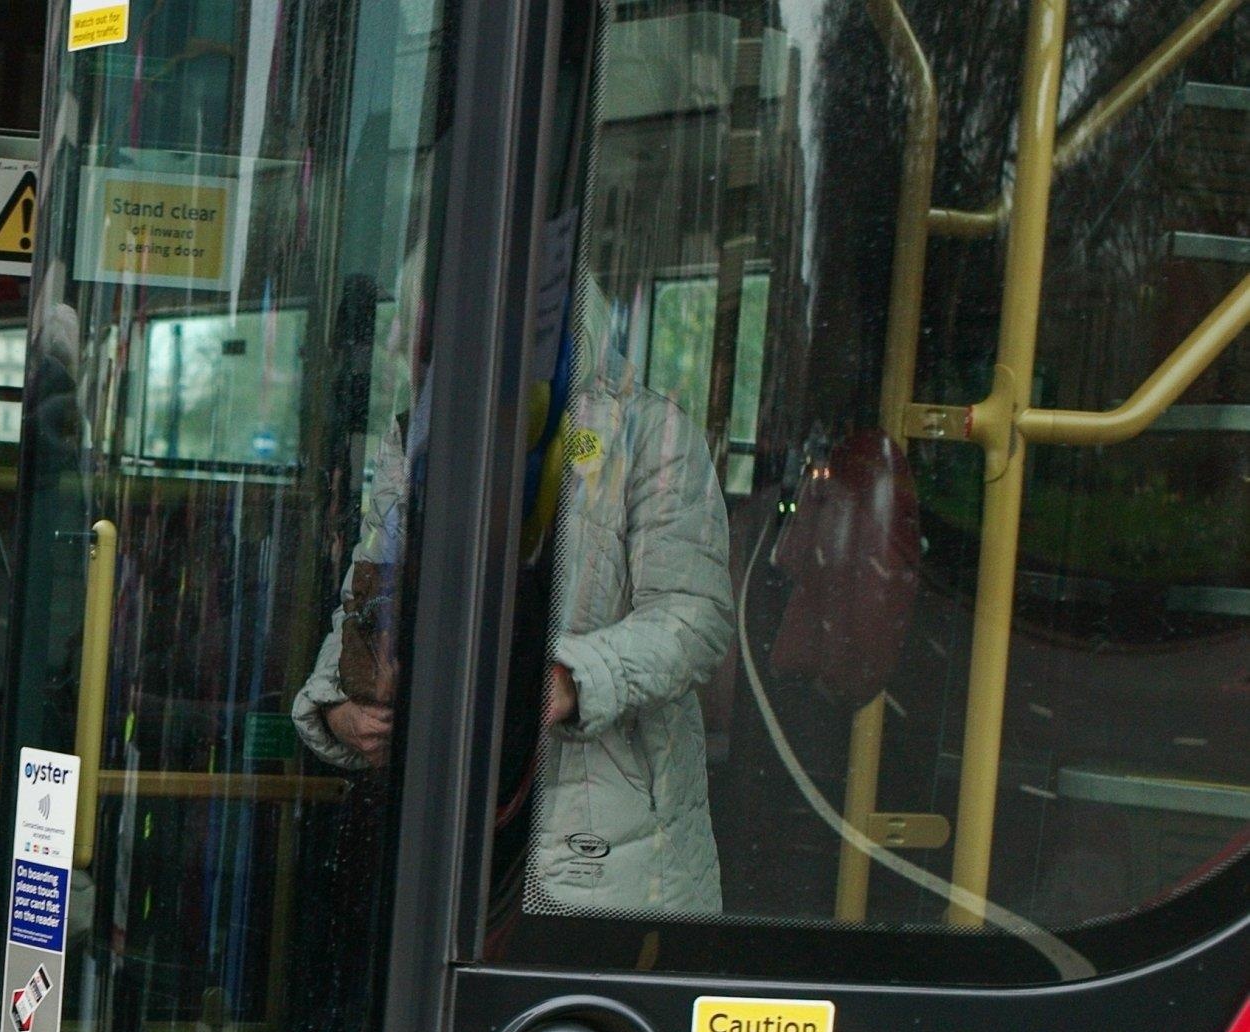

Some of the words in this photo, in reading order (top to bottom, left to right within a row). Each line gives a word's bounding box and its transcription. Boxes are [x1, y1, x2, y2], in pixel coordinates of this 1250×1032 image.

[74, 17, 94, 28] Watch
[96, 15, 108, 25] out
[109, 11, 121, 22] for
[96, 25, 120, 37] traffic
[111, 198, 164, 217] Stand
[170, 203, 217, 221] clear
[131, 225, 147, 236] of
[150, 225, 194, 240] inward
[118, 242, 171, 258] opening
[173, 244, 206, 258] door
[25, 761, 69, 784] oyster
[17, 865, 28, 878] On
[28, 867, 59, 887] boarding
[15, 880, 38, 895] please
[38, 885, 60, 899] touch
[14, 896, 31, 907] your
[30, 900, 46, 911] card
[46, 900, 61, 914] flat
[13, 909, 24, 920] on
[23, 910, 36, 923] the
[35, 914, 60, 928] reader
